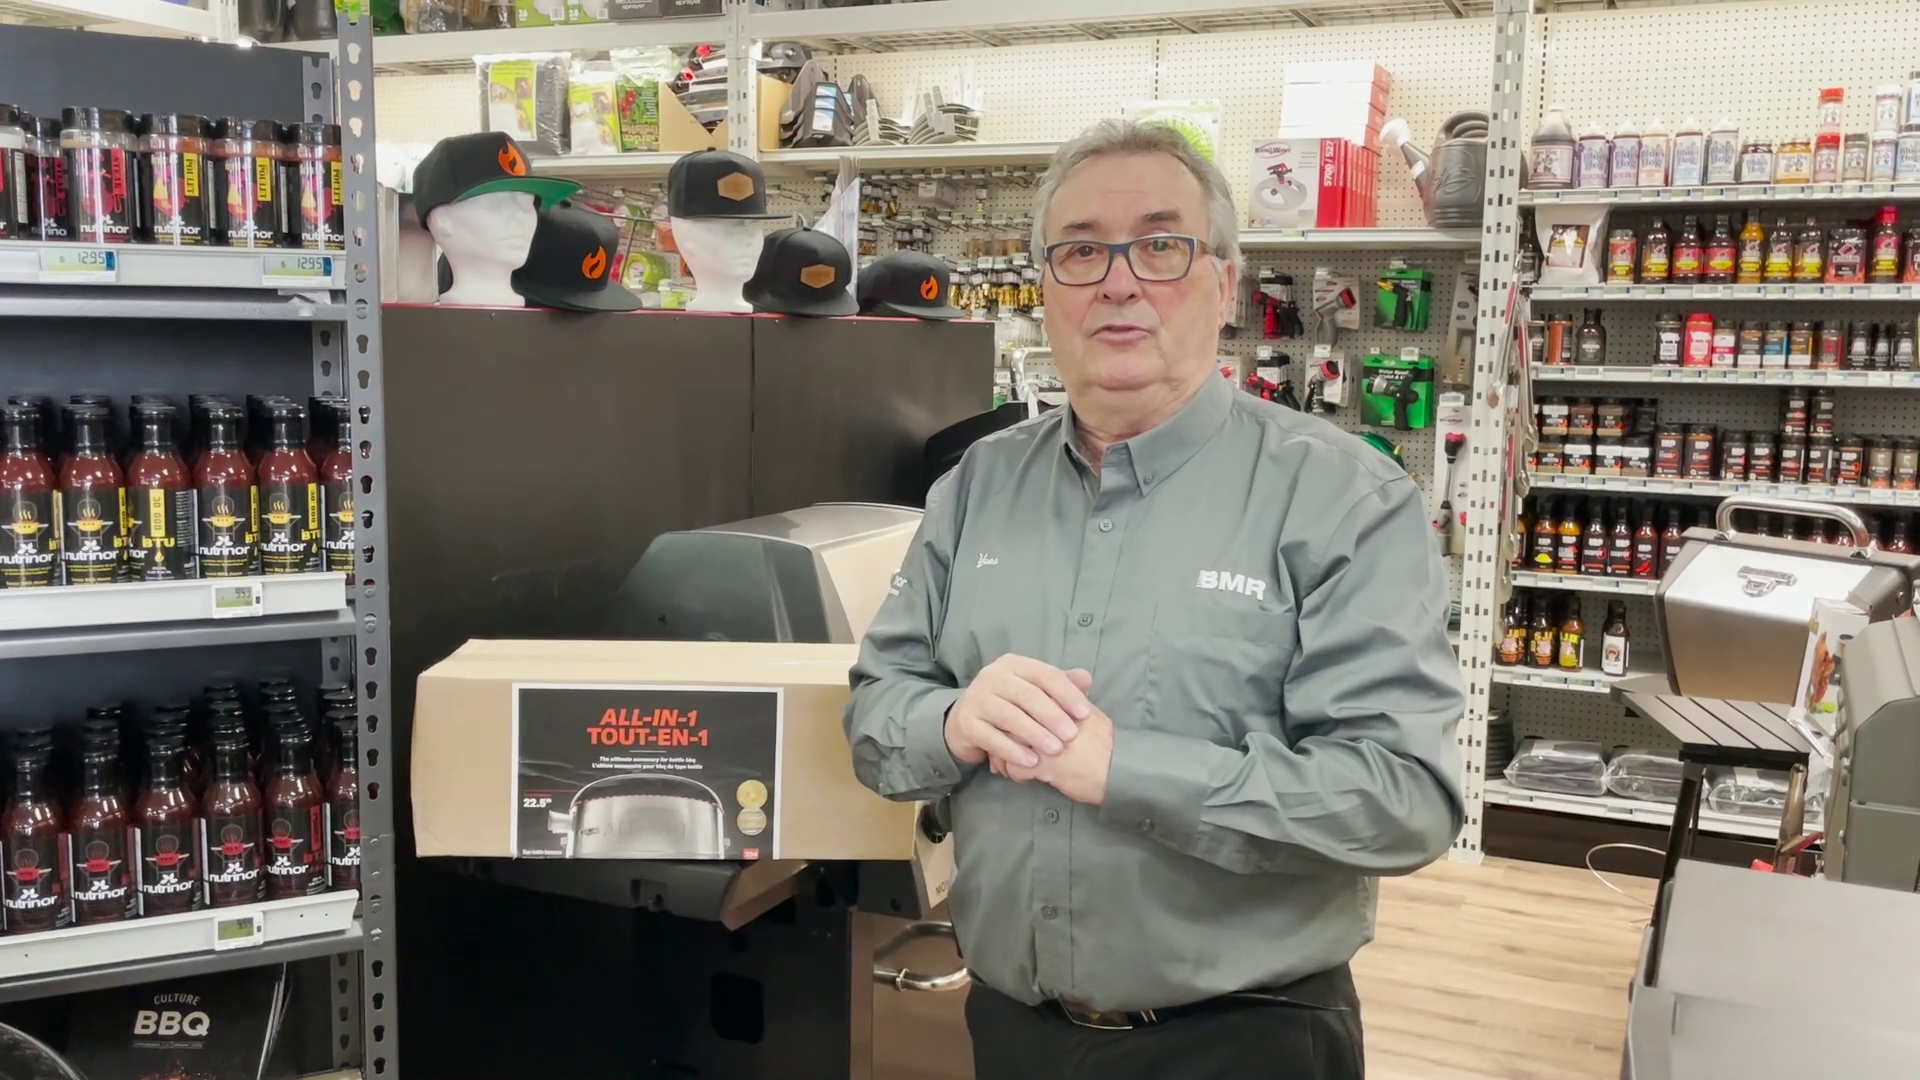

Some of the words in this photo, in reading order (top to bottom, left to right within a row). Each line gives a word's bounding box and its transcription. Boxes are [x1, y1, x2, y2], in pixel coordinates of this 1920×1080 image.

[142, 536, 175, 548] BTU
[260, 543, 307, 552] nutrinor
[65, 550, 119, 563] nutrinor
[200, 545, 250, 556] nutrinor
[0, 553, 54, 565] nutrinor
[1195, 569, 1266, 601] BMR
[599, 708, 698, 727] ALL-IN-1
[587, 727, 708, 746] TOUT-EN-1
[210, 869, 260, 883] nutrinor
[75, 886, 127, 901] nutrinor
[144, 880, 194, 894] nutrinor
[5, 895, 58, 909] nutrinor
[153, 993, 201, 1006] CULTURE
[134, 1010, 211, 1037] BBQ
